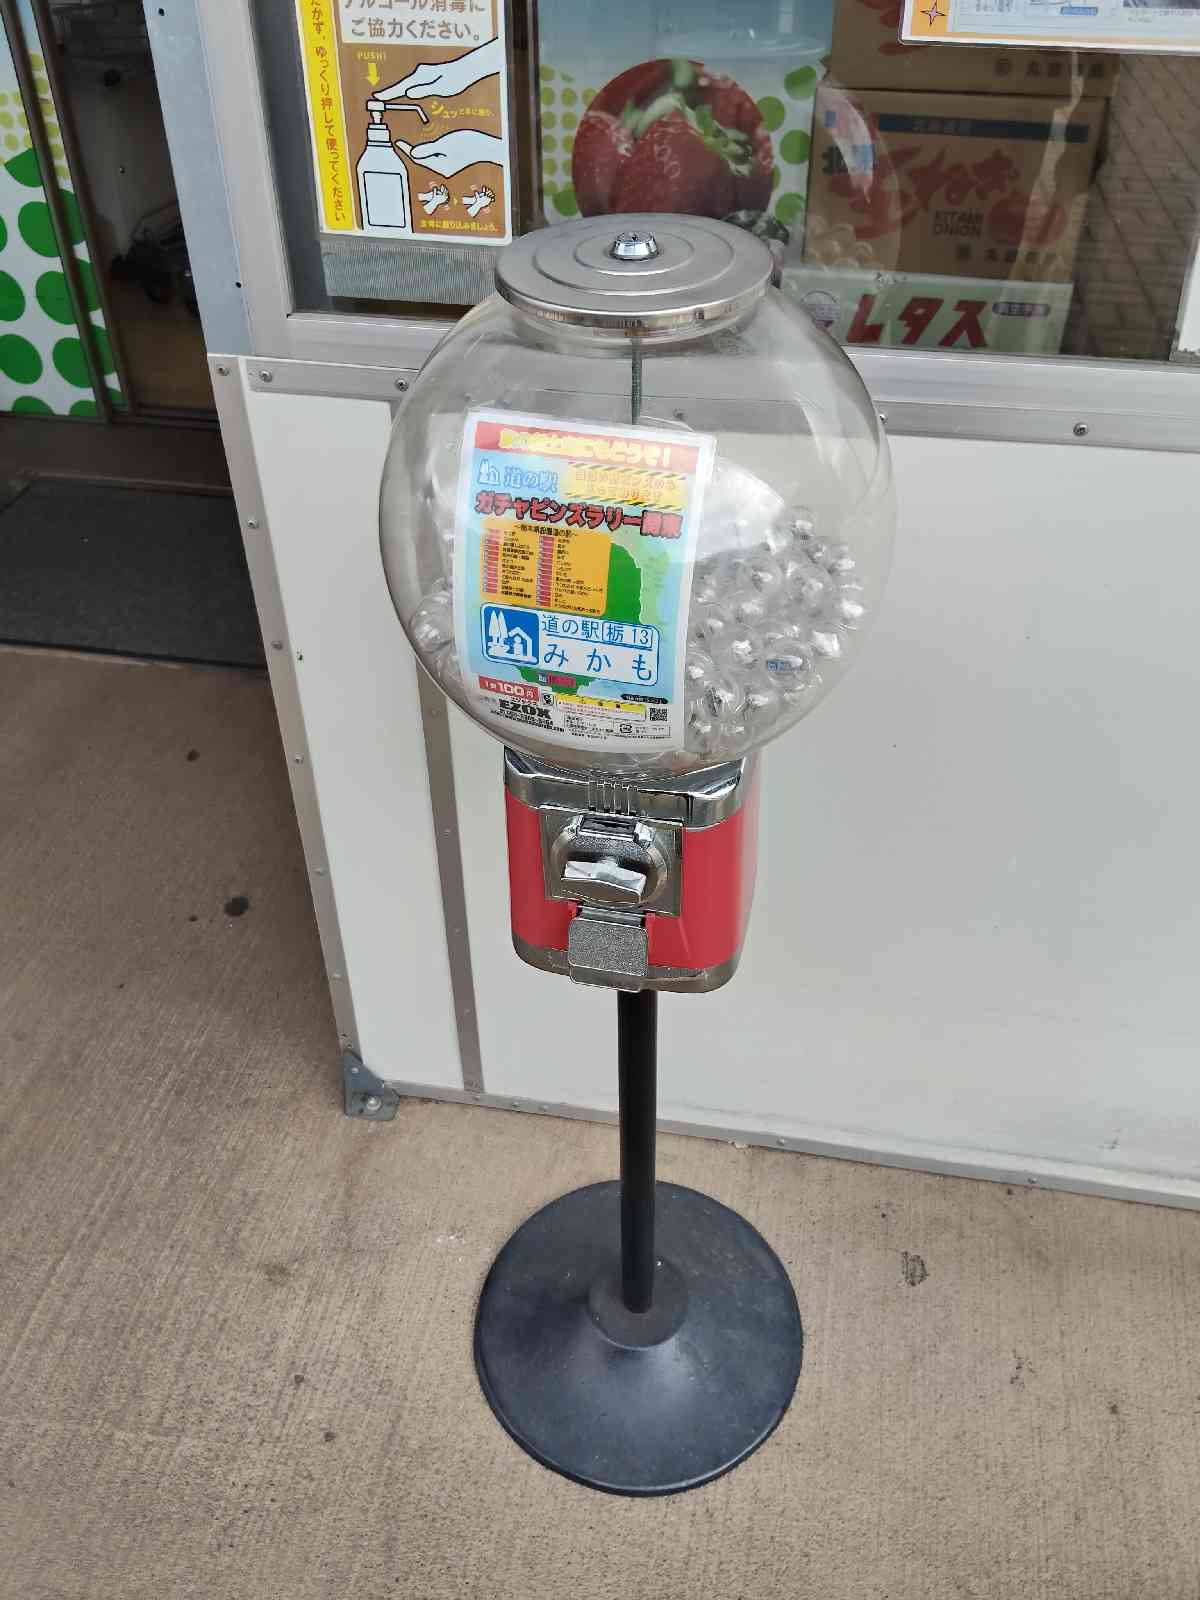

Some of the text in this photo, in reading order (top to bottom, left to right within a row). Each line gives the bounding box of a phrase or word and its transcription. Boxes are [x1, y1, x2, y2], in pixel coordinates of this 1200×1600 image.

[351, 18, 480, 41] ご協力ください。
[933, 223, 982, 238] ONION
[846, 293, 990, 348] レタス
[541, 614, 601, 641] 道の駅
[632, 627, 649, 645] 13
[543, 643, 653, 681] みかも
[499, 699, 553, 720] EZOX
